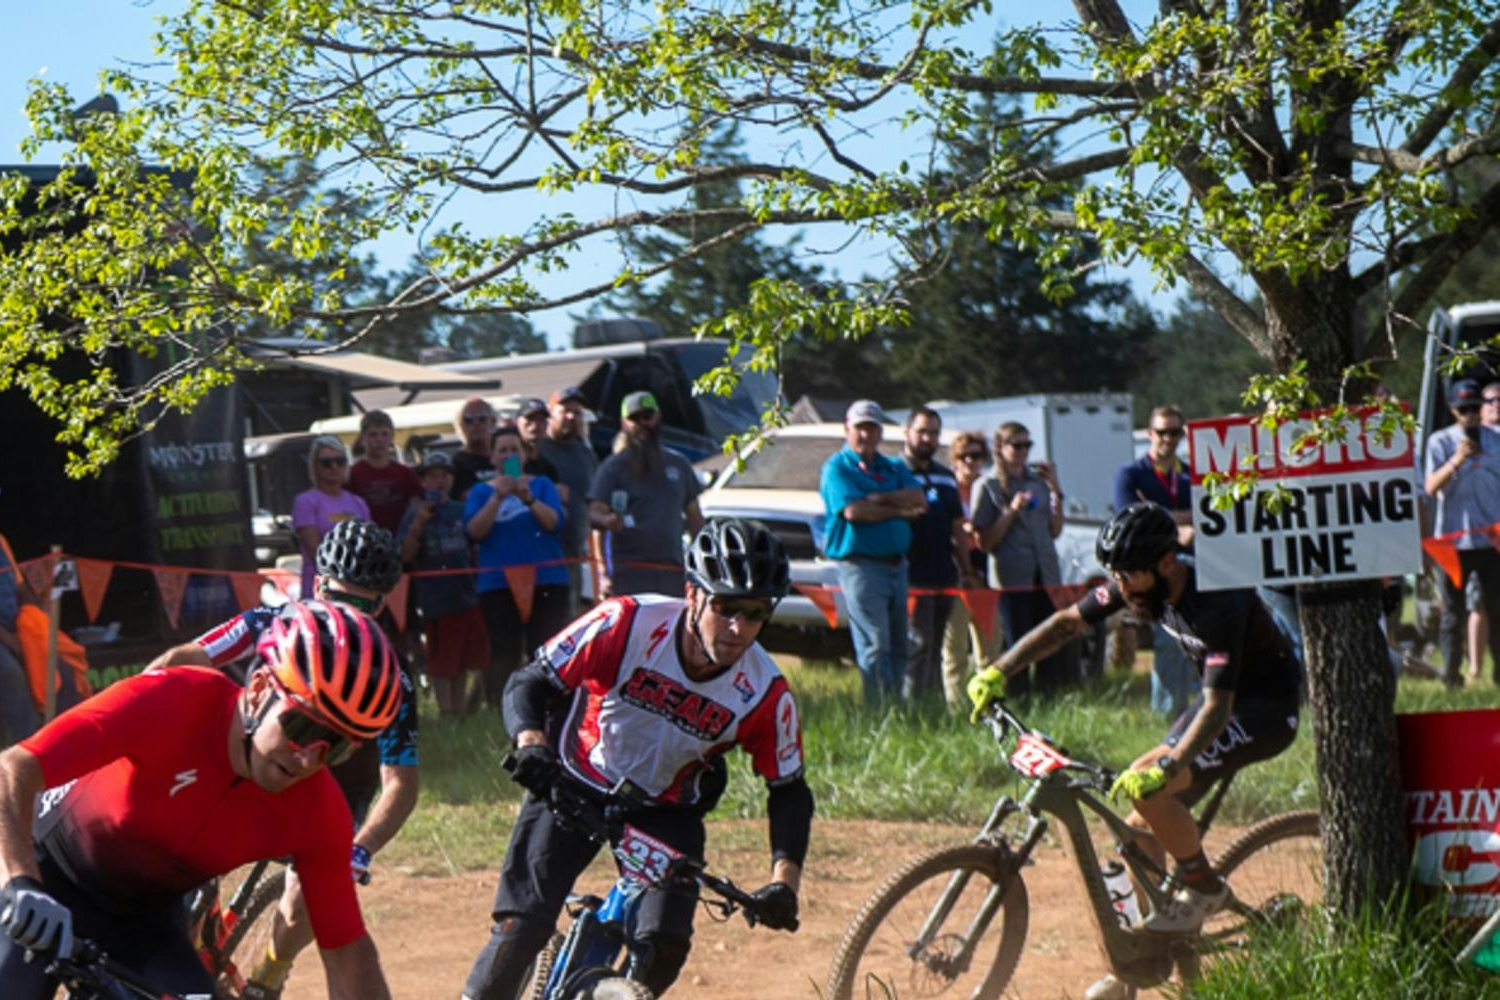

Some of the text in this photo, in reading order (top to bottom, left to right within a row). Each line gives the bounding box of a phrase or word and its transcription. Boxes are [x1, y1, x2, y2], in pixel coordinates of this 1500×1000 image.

[1192, 410, 1409, 476] MICRO
[1200, 478, 1414, 537] STARTING
[1261, 531, 1357, 580] LINE
[625, 668, 736, 741] GEAR
